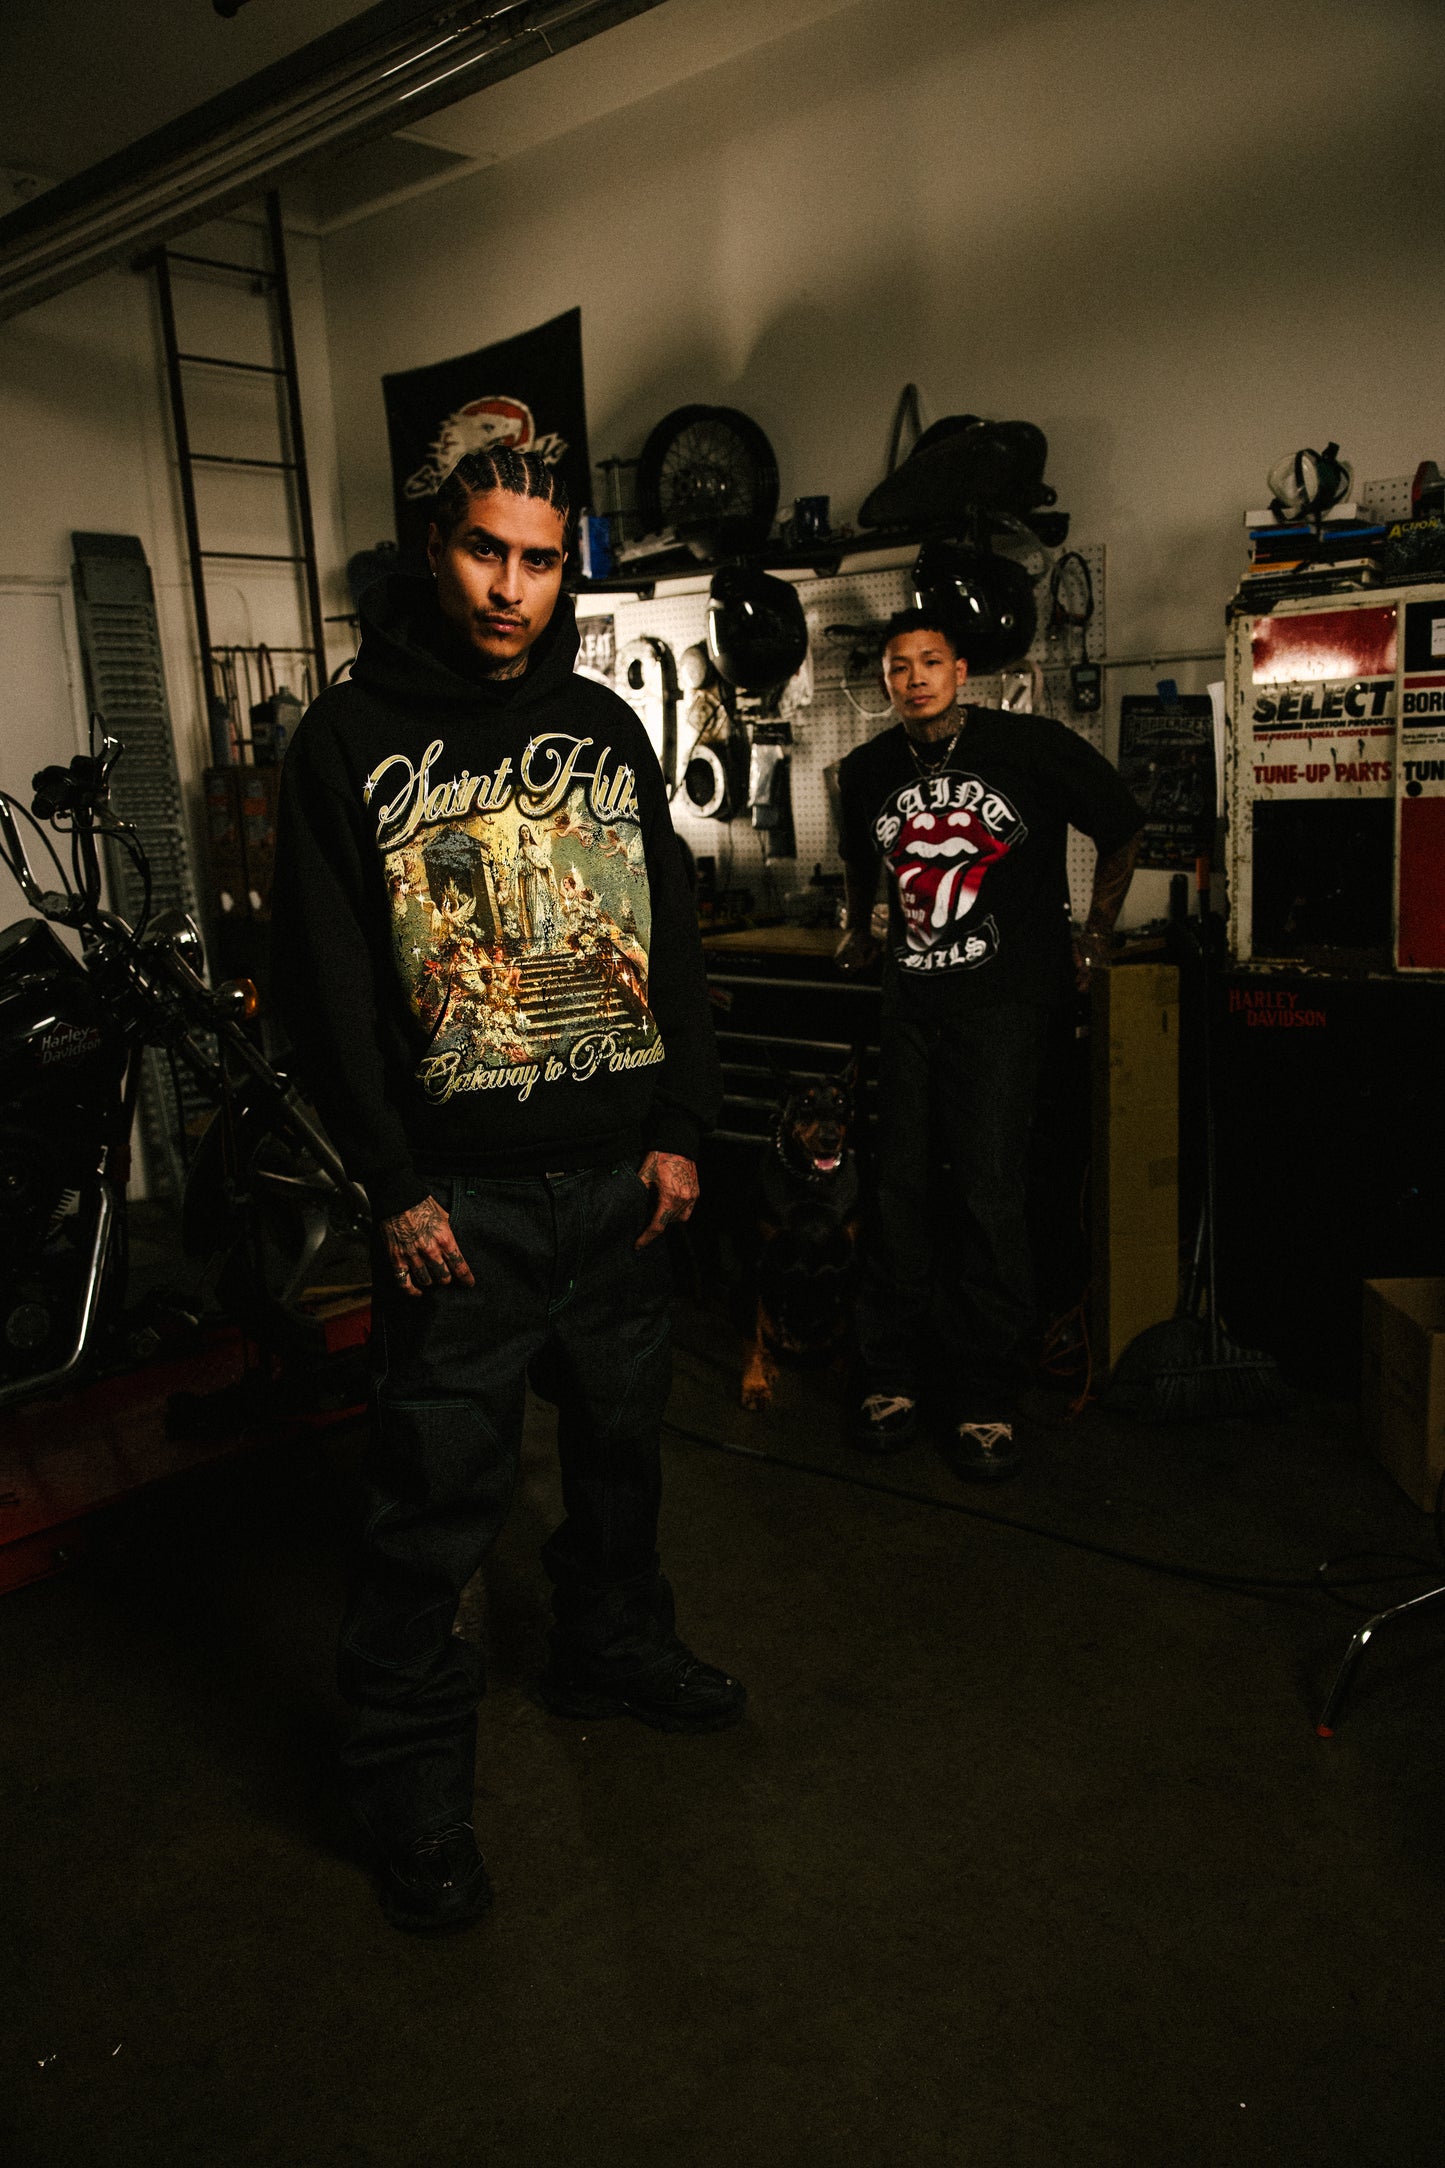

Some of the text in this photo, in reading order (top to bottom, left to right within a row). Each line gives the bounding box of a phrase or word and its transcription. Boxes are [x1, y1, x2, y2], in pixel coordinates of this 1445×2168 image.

[1253, 680, 1395, 723] SELECT
[1403, 692, 1445, 713] BOR
[1305, 717, 1396, 729] IGNITION PRODUCTS
[1337, 728, 1368, 738] CHOICE
[1253, 761, 1393, 784] TUNE-UP PARTS
[363, 739, 514, 850] Saint
[875, 775, 1017, 848] SAINT
[1228, 986, 1299, 1013] HARLEY
[1247, 1008, 1328, 1028] DAVIDSON
[415, 1051, 540, 1106] Gateway
[544, 1055, 567, 1082] to
